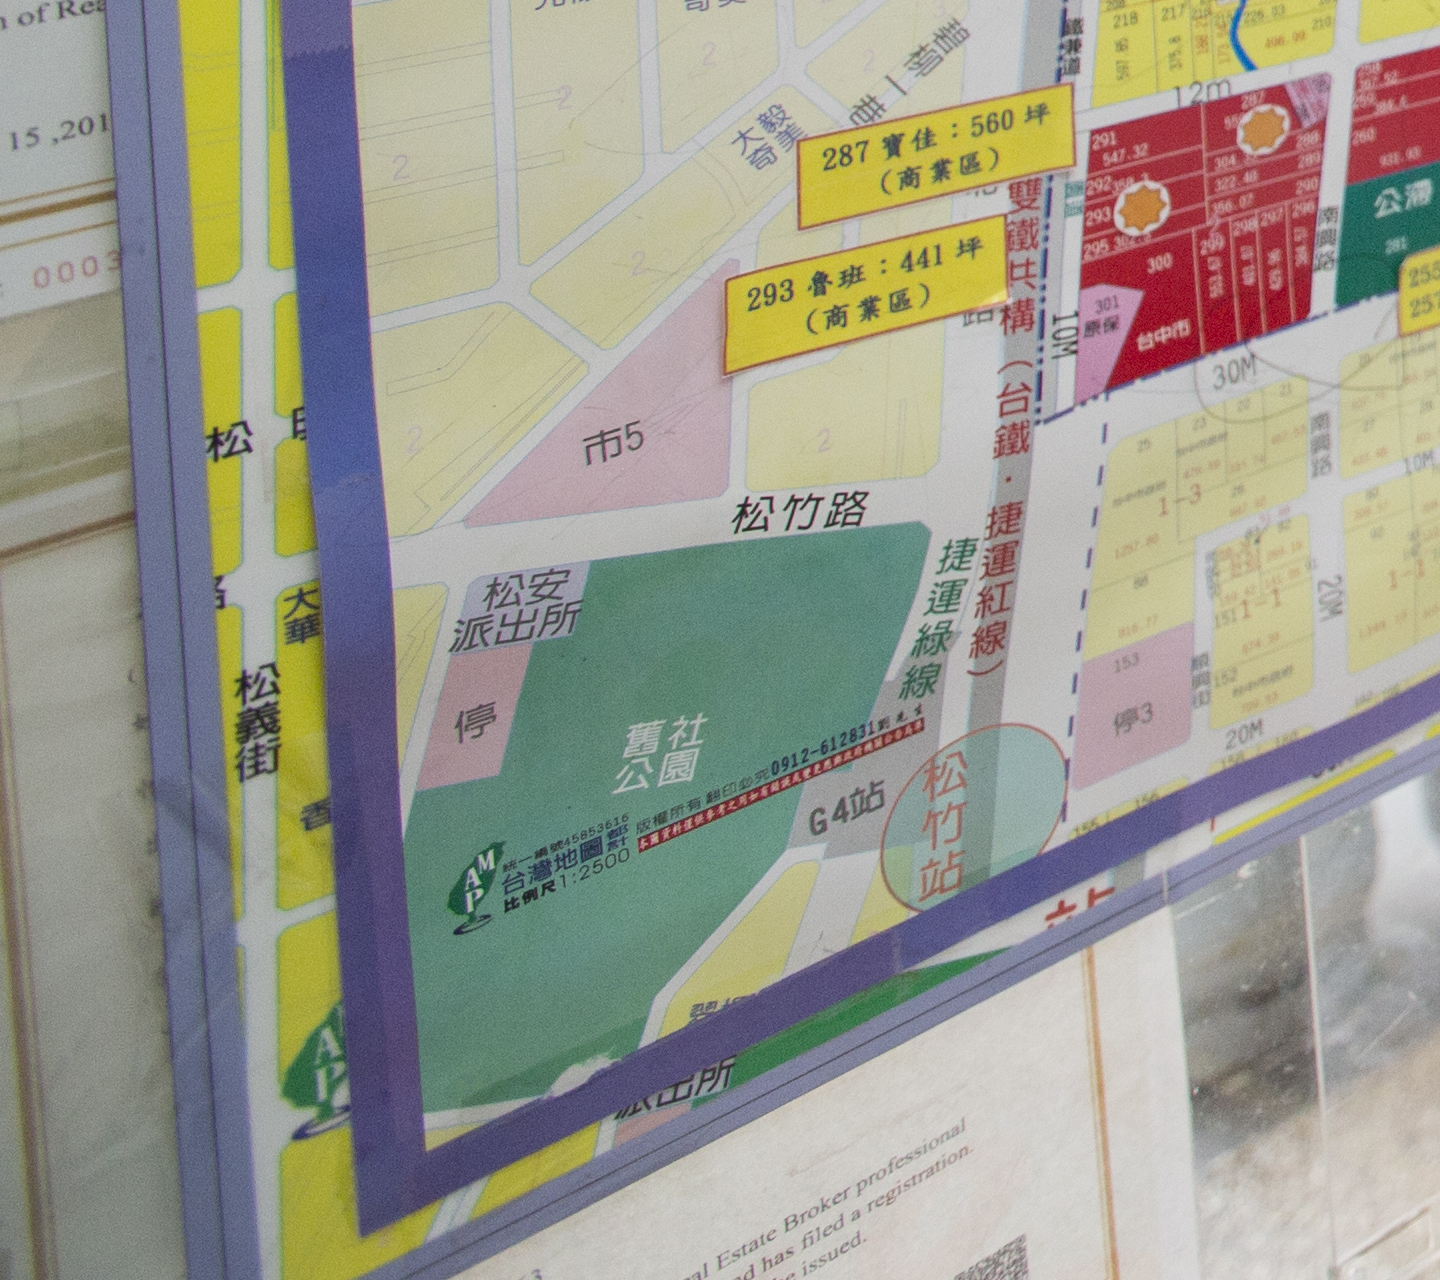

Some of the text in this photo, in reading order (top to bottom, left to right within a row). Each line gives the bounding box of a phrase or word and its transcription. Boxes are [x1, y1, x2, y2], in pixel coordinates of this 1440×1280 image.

[17, 2, 50, 27] of
[1172, 76, 1233, 107] 12m
[10, 126, 41, 151] 15
[821, 140, 871, 173] 287
[1314, 205, 1340, 273] 南興路
[746, 243, 944, 312] 293 魯班：441
[1136, 318, 1191, 353] 台中市
[1212, 353, 1258, 392] 30M
[582, 421, 646, 467] 市5
[731, 489, 869, 535] 松竹路
[482, 566, 571, 611] 松安
[448, 601, 582, 653] 派出所
[899, 536, 979, 700] 捷運綠線
[234, 662, 282, 783] 松義街
[453, 702, 498, 743] 停
[623, 713, 708, 759] 舊社
[1112, 701, 1155, 738] 停3
[612, 749, 700, 796] 公園
[636, 720, 876, 835] 版權所有 翻印必究 0912-612831
[808, 780, 886, 836] G4站
[916, 751, 969, 903] 松竹站
[501, 834, 604, 895] 台灣地圖
[714, 1116, 967, 1272] Estate Broker professional
[762, 1144, 975, 1272] has filed a registration.
[801, 1230, 868, 1278] issued.
